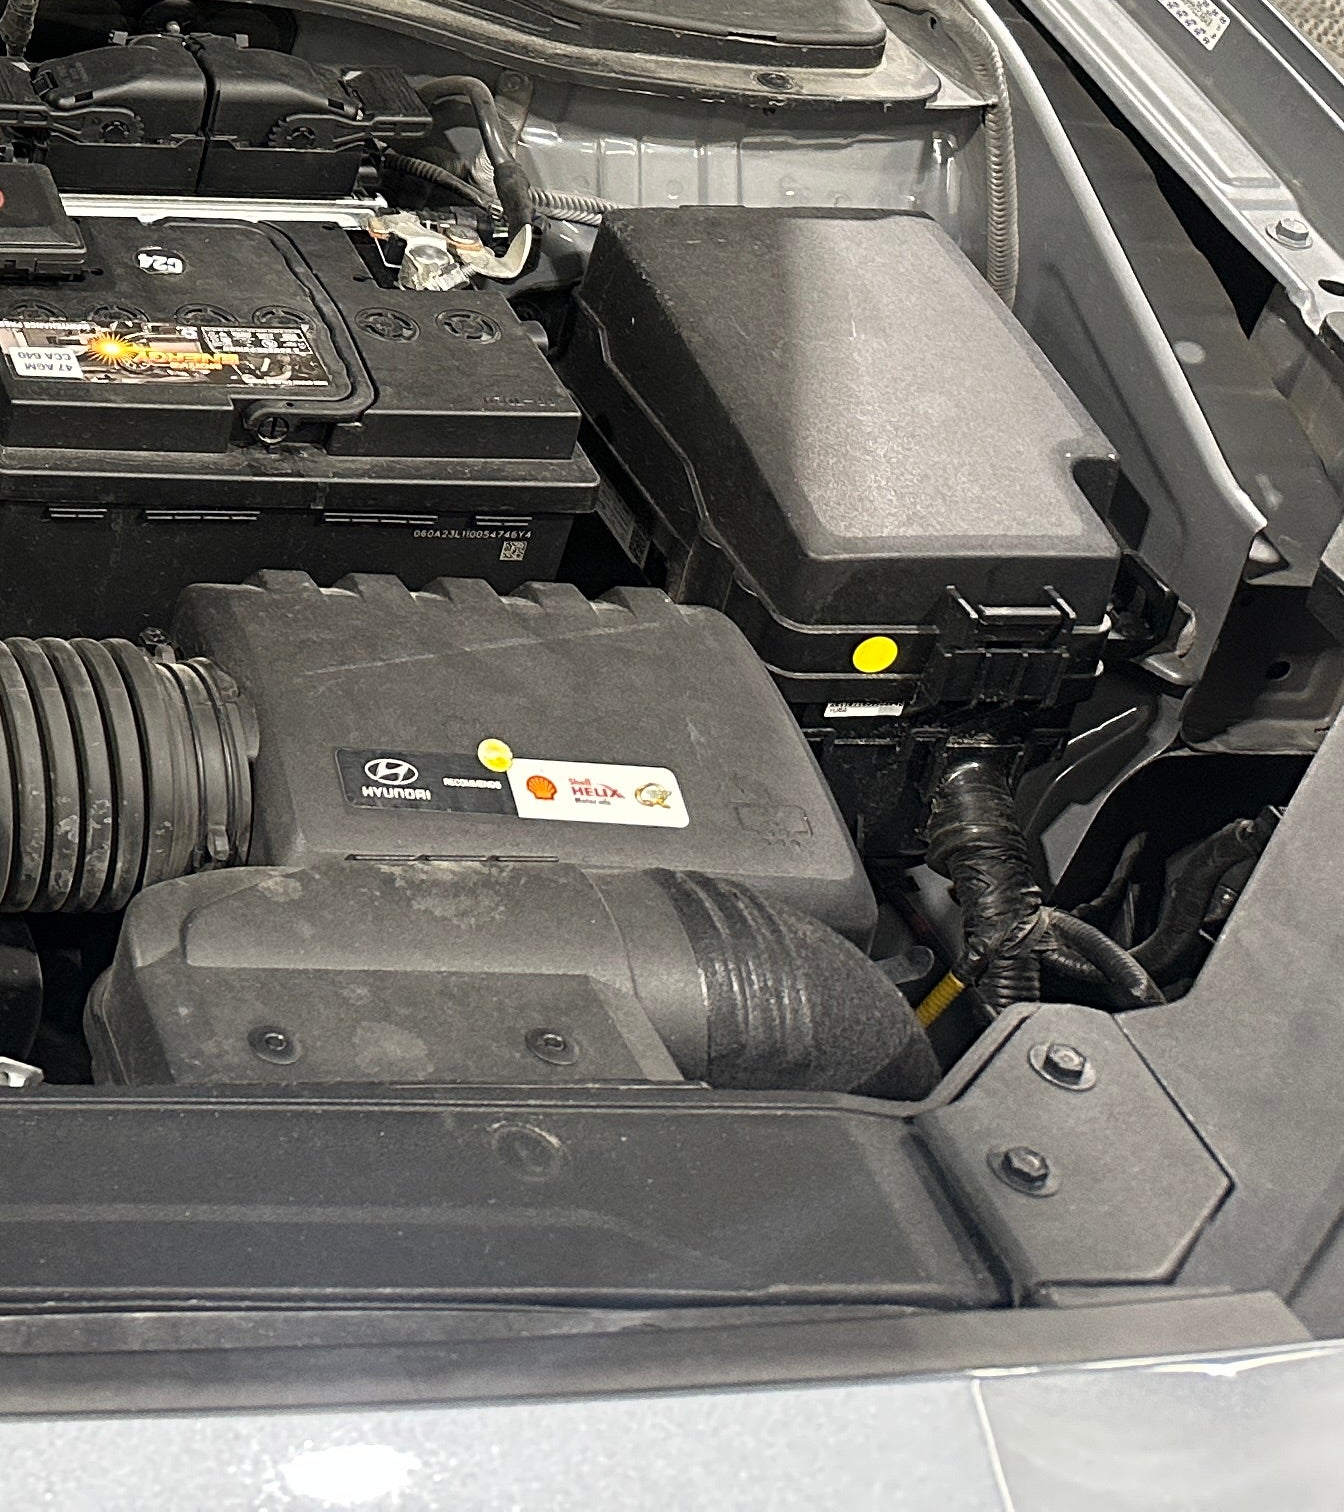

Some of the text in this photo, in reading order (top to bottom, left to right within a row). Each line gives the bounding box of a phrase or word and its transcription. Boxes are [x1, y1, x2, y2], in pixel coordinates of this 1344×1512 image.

[138, 253, 183, 274] C24
[16, 350, 72, 361] CCA 640
[132, 350, 239, 365] ENERGY
[24, 361, 73, 372] 47 AGM
[568, 778, 592, 787] Shell
[361, 786, 432, 801] HYUNDAI
[571, 785, 625, 799] HELIX
